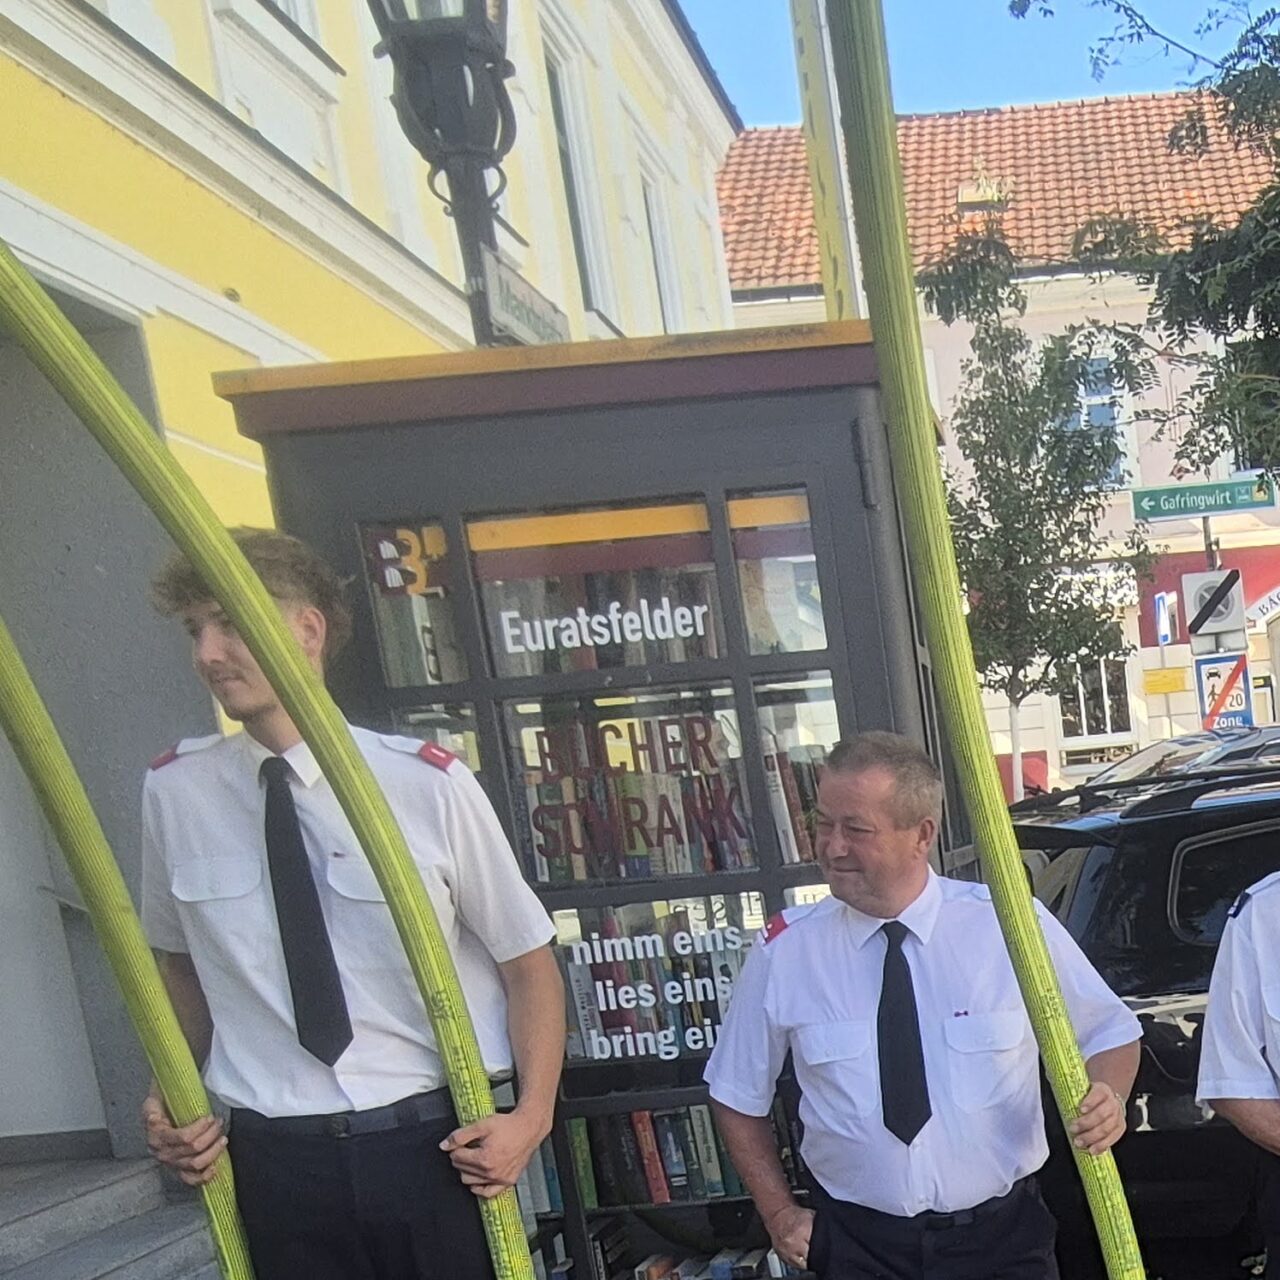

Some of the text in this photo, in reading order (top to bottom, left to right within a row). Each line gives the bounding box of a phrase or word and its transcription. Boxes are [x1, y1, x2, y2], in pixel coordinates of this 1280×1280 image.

[1160, 489, 1232, 511] Gafringwirt
[501, 596, 709, 654] Euratsfelder
[1229, 693, 1244, 708] 20
[1213, 716, 1243, 728] Zone
[532, 773, 748, 858] SCHRANK
[572, 924, 743, 966] nimm eins
[594, 979, 656, 1012] lies
[664, 972, 733, 1005] eins
[590, 1017, 722, 1061] bring ei
